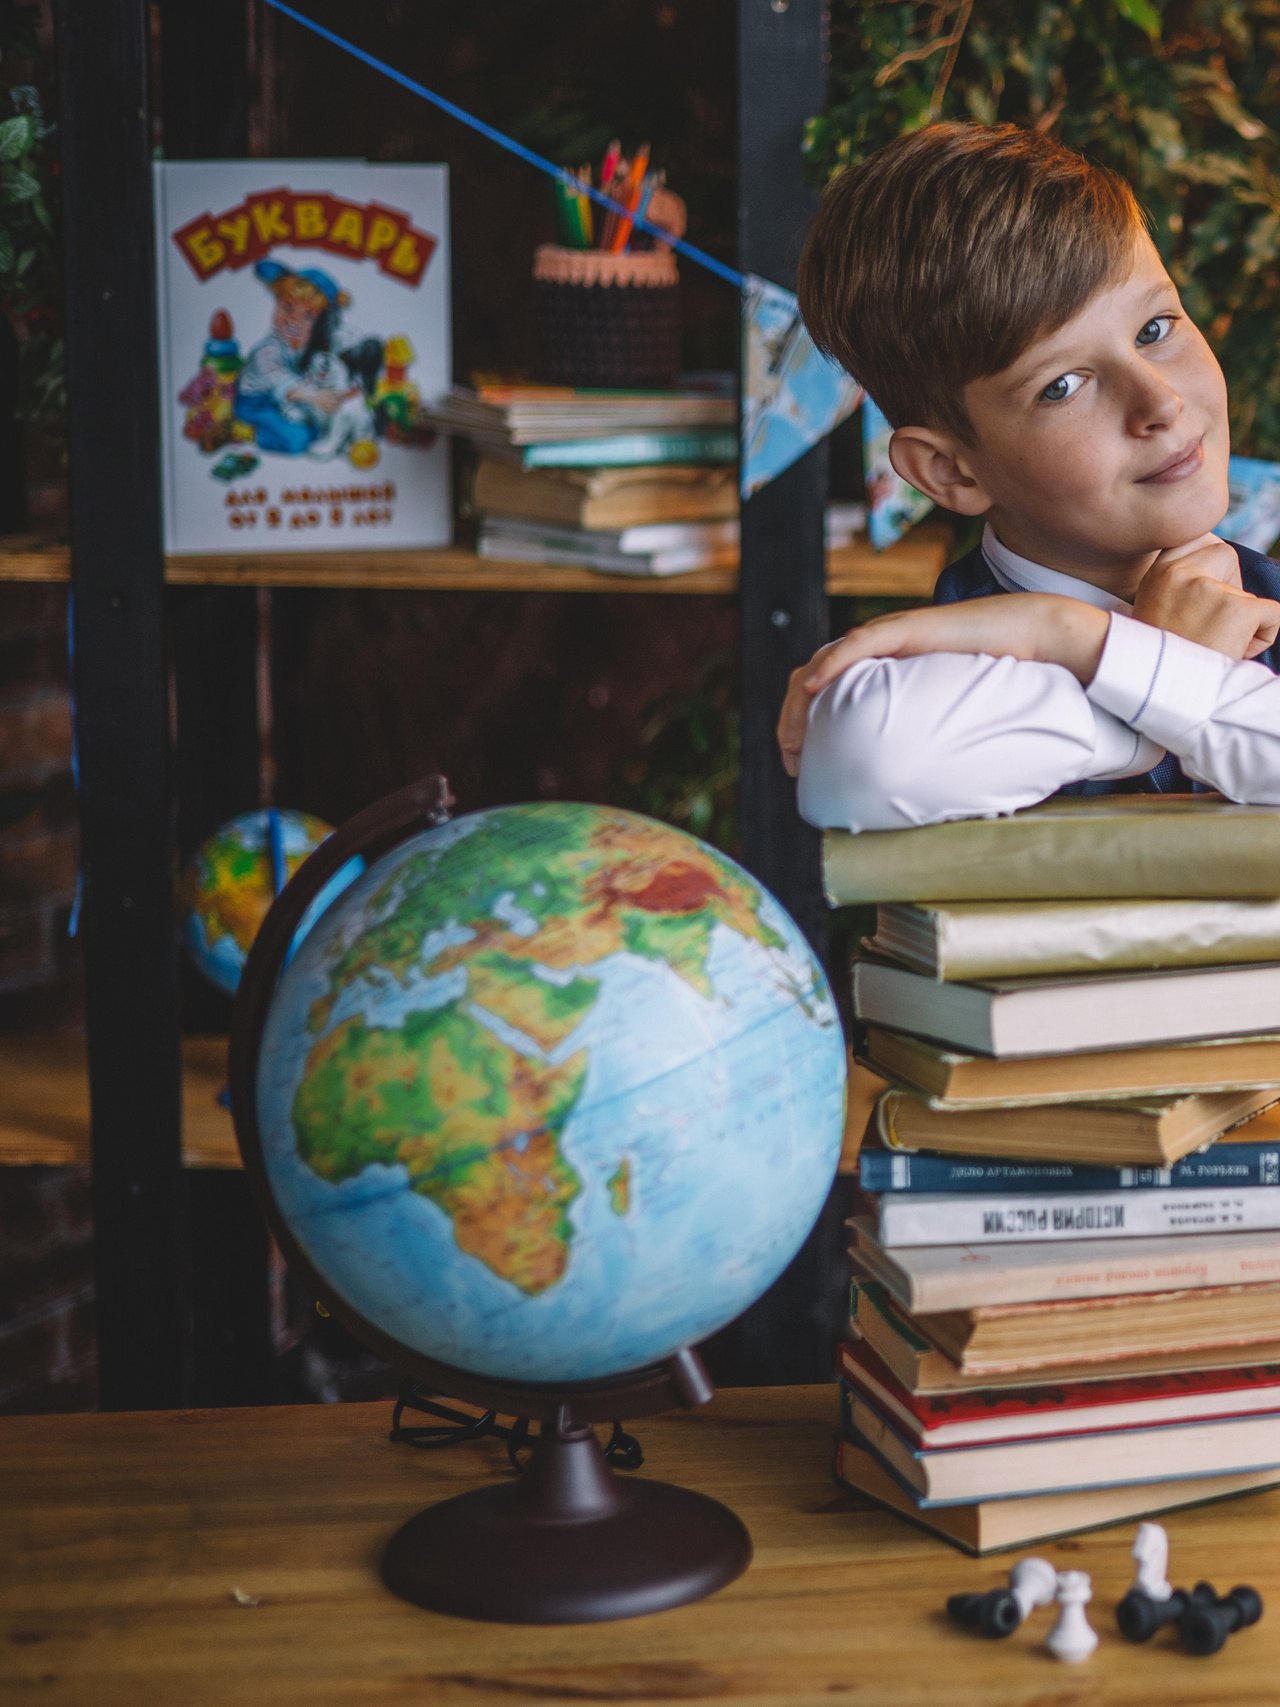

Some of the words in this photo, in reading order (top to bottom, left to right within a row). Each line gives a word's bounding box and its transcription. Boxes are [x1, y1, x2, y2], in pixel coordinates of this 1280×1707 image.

[185, 201, 421, 274] БУКВАРЬ
[951, 1167, 984, 1179] ДЕЛО
[986, 1166, 1074, 1178] АРТАМОНОВЫХ
[1180, 1165, 1195, 1177] М.
[1198, 1164, 1250, 1178] ГОРЬКИЙ
[983, 1208, 1048, 1234] РОССИИ
[1052, 1204, 1126, 1230] ИСТОРИЯ
